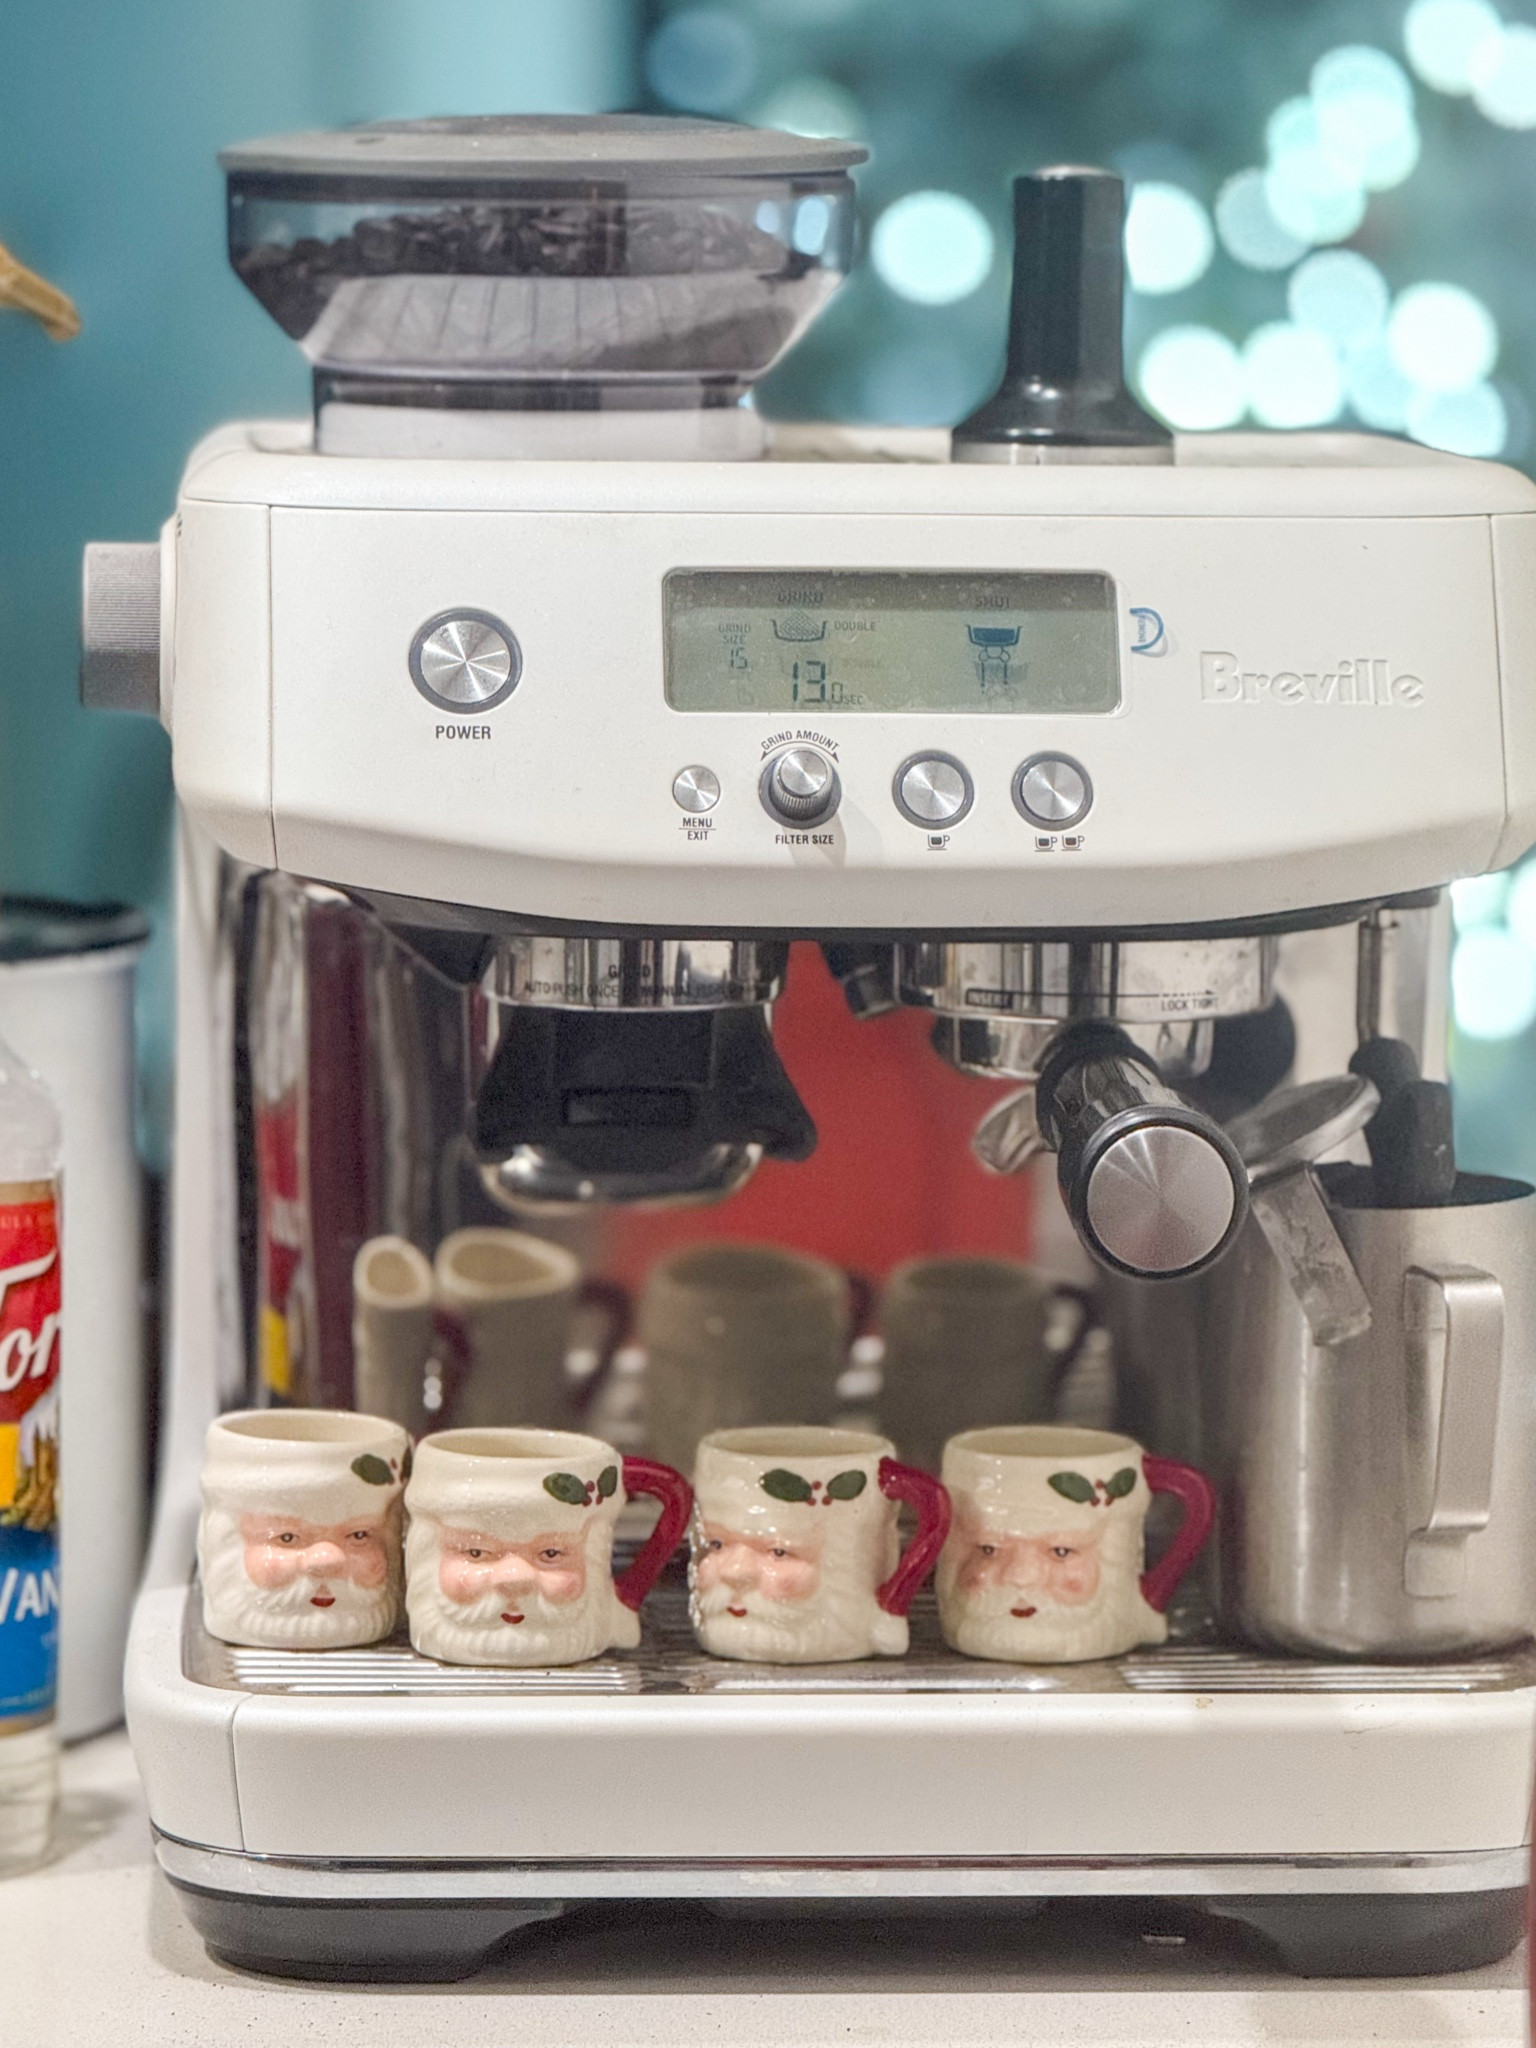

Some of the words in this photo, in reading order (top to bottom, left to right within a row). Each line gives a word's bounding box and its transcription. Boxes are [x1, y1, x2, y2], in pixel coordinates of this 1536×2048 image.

[718, 624, 751, 633] GRIND
[834, 621, 877, 632] DOUBLE
[722, 635, 746, 645] SIZE
[1199, 650, 1425, 707] Breville
[435, 725, 492, 740] POWER
[760, 730, 793, 751] GRIND
[795, 729, 840, 751] AMOUNT
[682, 817, 713, 828] MENU
[687, 830, 709, 841] EXIT
[775, 834, 810, 845] FILTER
[811, 834, 835, 845] SIZE
